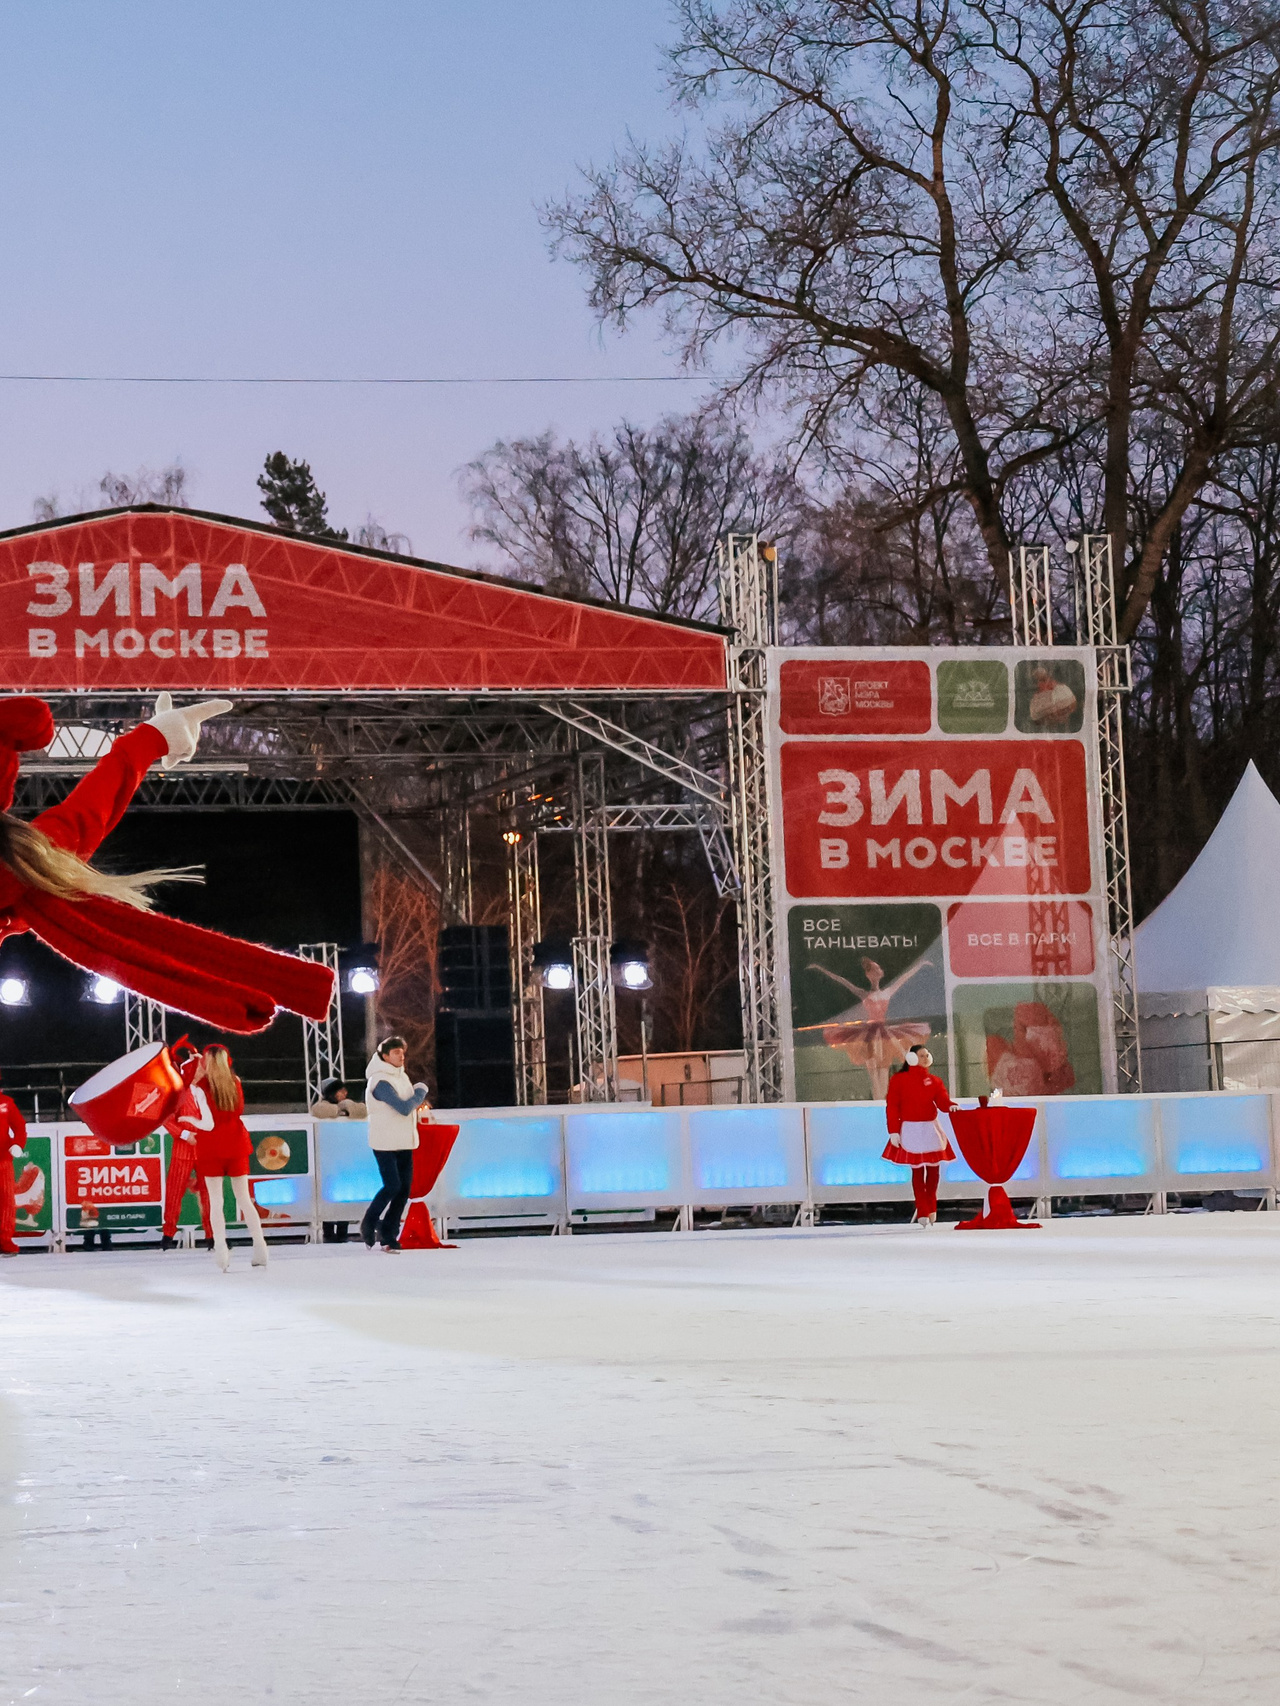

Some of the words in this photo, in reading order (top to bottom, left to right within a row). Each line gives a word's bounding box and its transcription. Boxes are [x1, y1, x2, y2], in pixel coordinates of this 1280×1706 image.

[26, 561, 267, 617] ЗИМА
[28, 628, 58, 658] В
[75, 627, 269, 659] МОСКВЕ
[817, 768, 1056, 827] ЗИМА
[820, 838, 850, 869] В
[866, 836, 1059, 869] МОСКВЕ
[803, 919, 841, 932] ВСЕ
[803, 935, 918, 950] ТАНЦЕВАТЬ!
[968, 932, 1003, 946] ВСЕ
[1008, 932, 1019, 945] В
[78, 1165, 149, 1185] ЗИМА
[78, 1187, 88, 1197] В
[91, 1185, 149, 1196] МОСКВЕ
